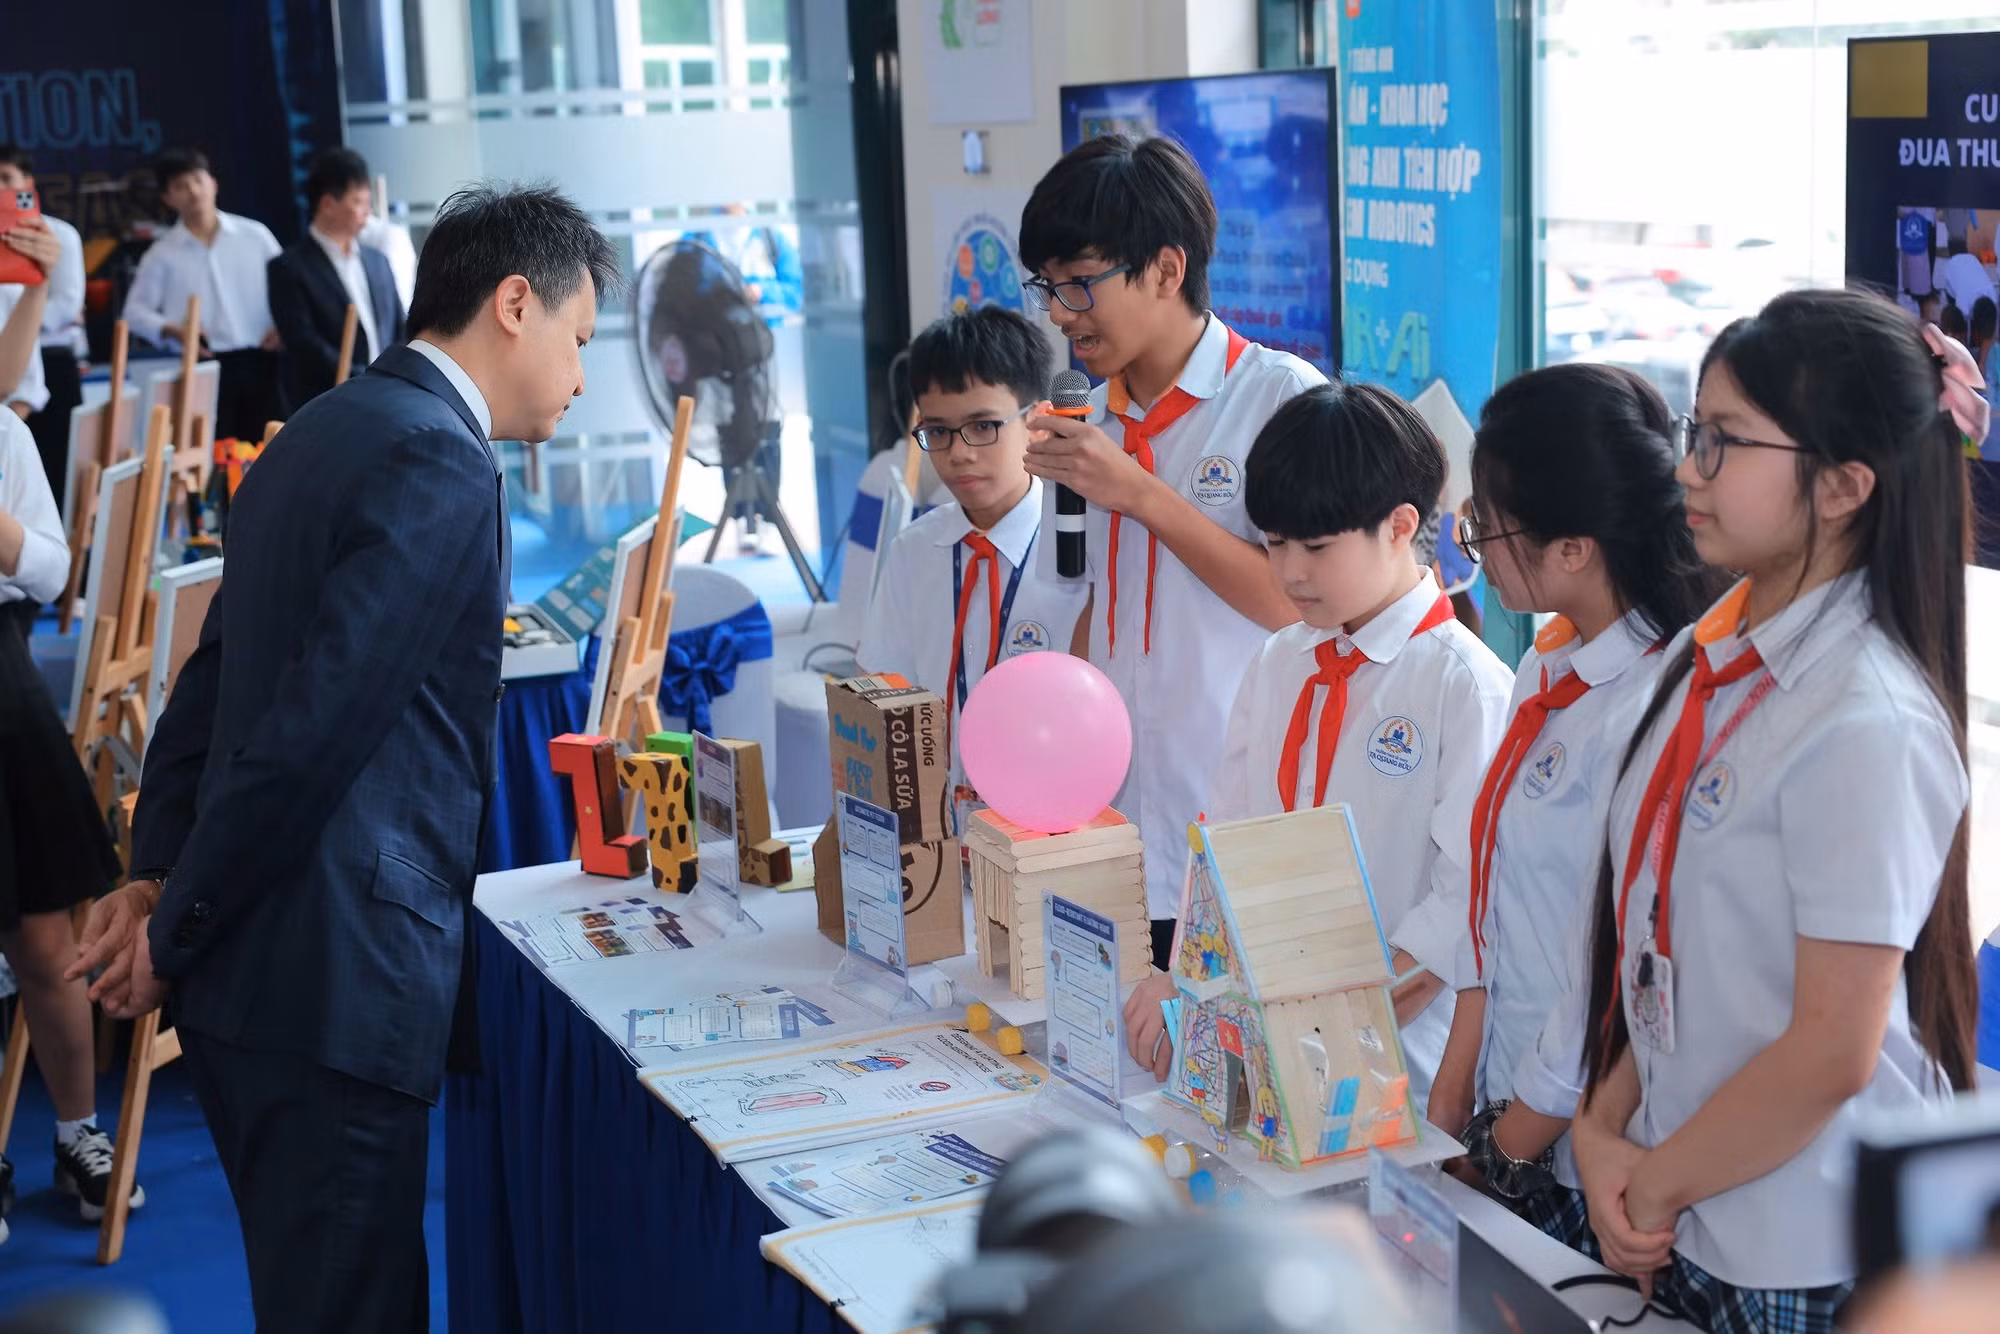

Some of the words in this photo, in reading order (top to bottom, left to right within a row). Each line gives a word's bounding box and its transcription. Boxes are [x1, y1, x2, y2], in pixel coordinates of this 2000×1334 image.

[1899, 138, 1951, 167] ĐUA
[891, 720, 909, 744] CÔ
[893, 748, 908, 770] LA
[921, 728, 937, 767] UỐNG
[895, 774, 914, 810] SỮA
